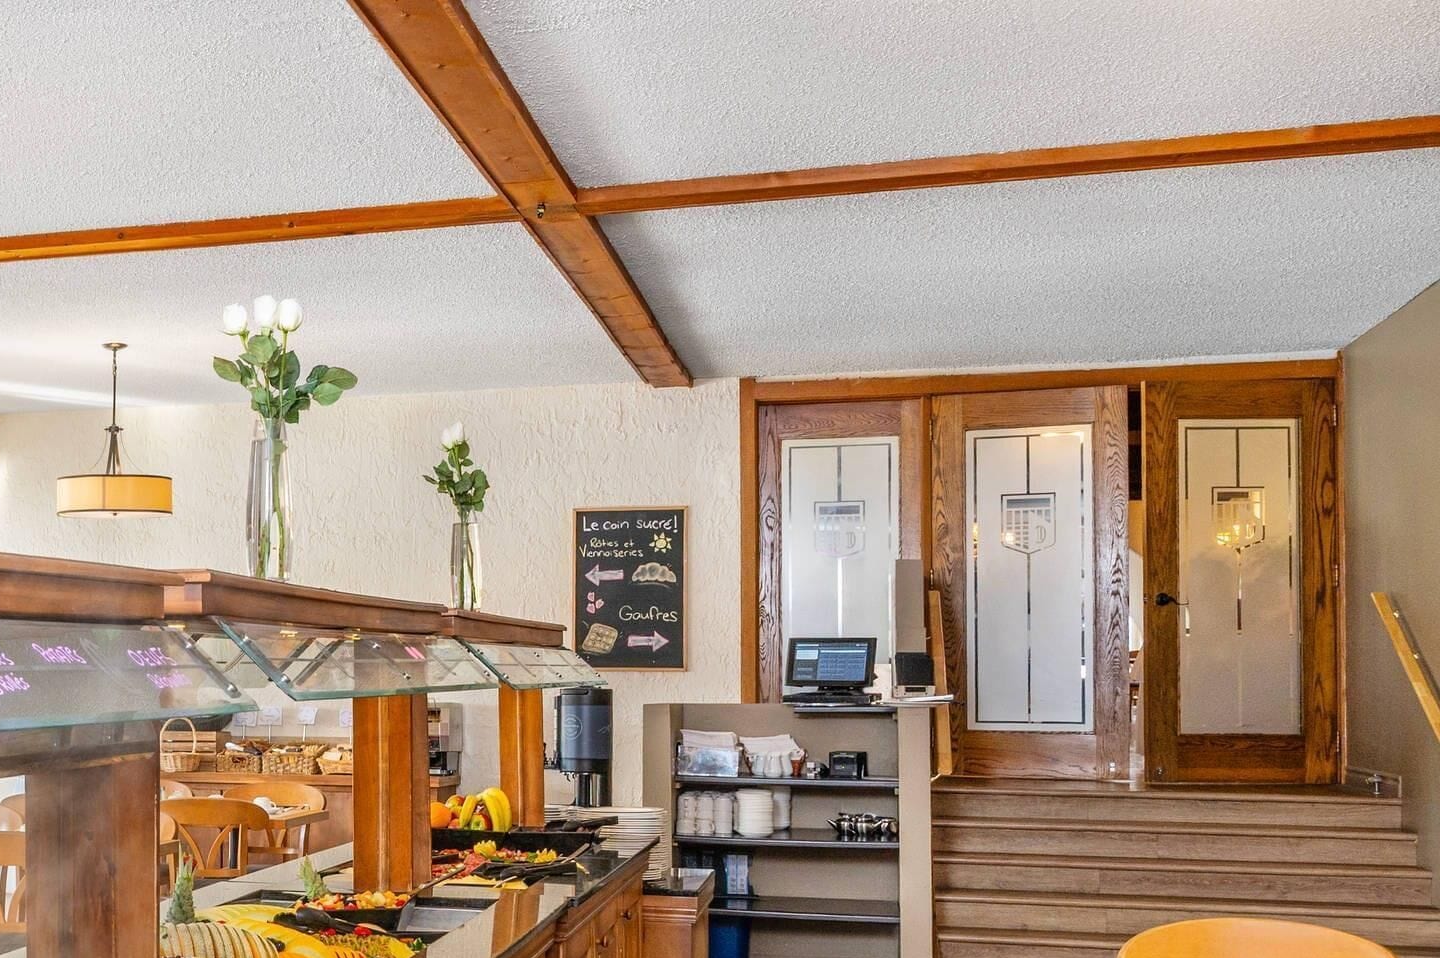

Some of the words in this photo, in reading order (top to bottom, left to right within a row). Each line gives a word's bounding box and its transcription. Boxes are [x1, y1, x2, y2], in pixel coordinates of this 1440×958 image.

[582, 515, 600, 532] Le
[602, 520, 630, 530] coin
[636, 514, 678, 534] sucré!
[623, 538, 635, 548] et
